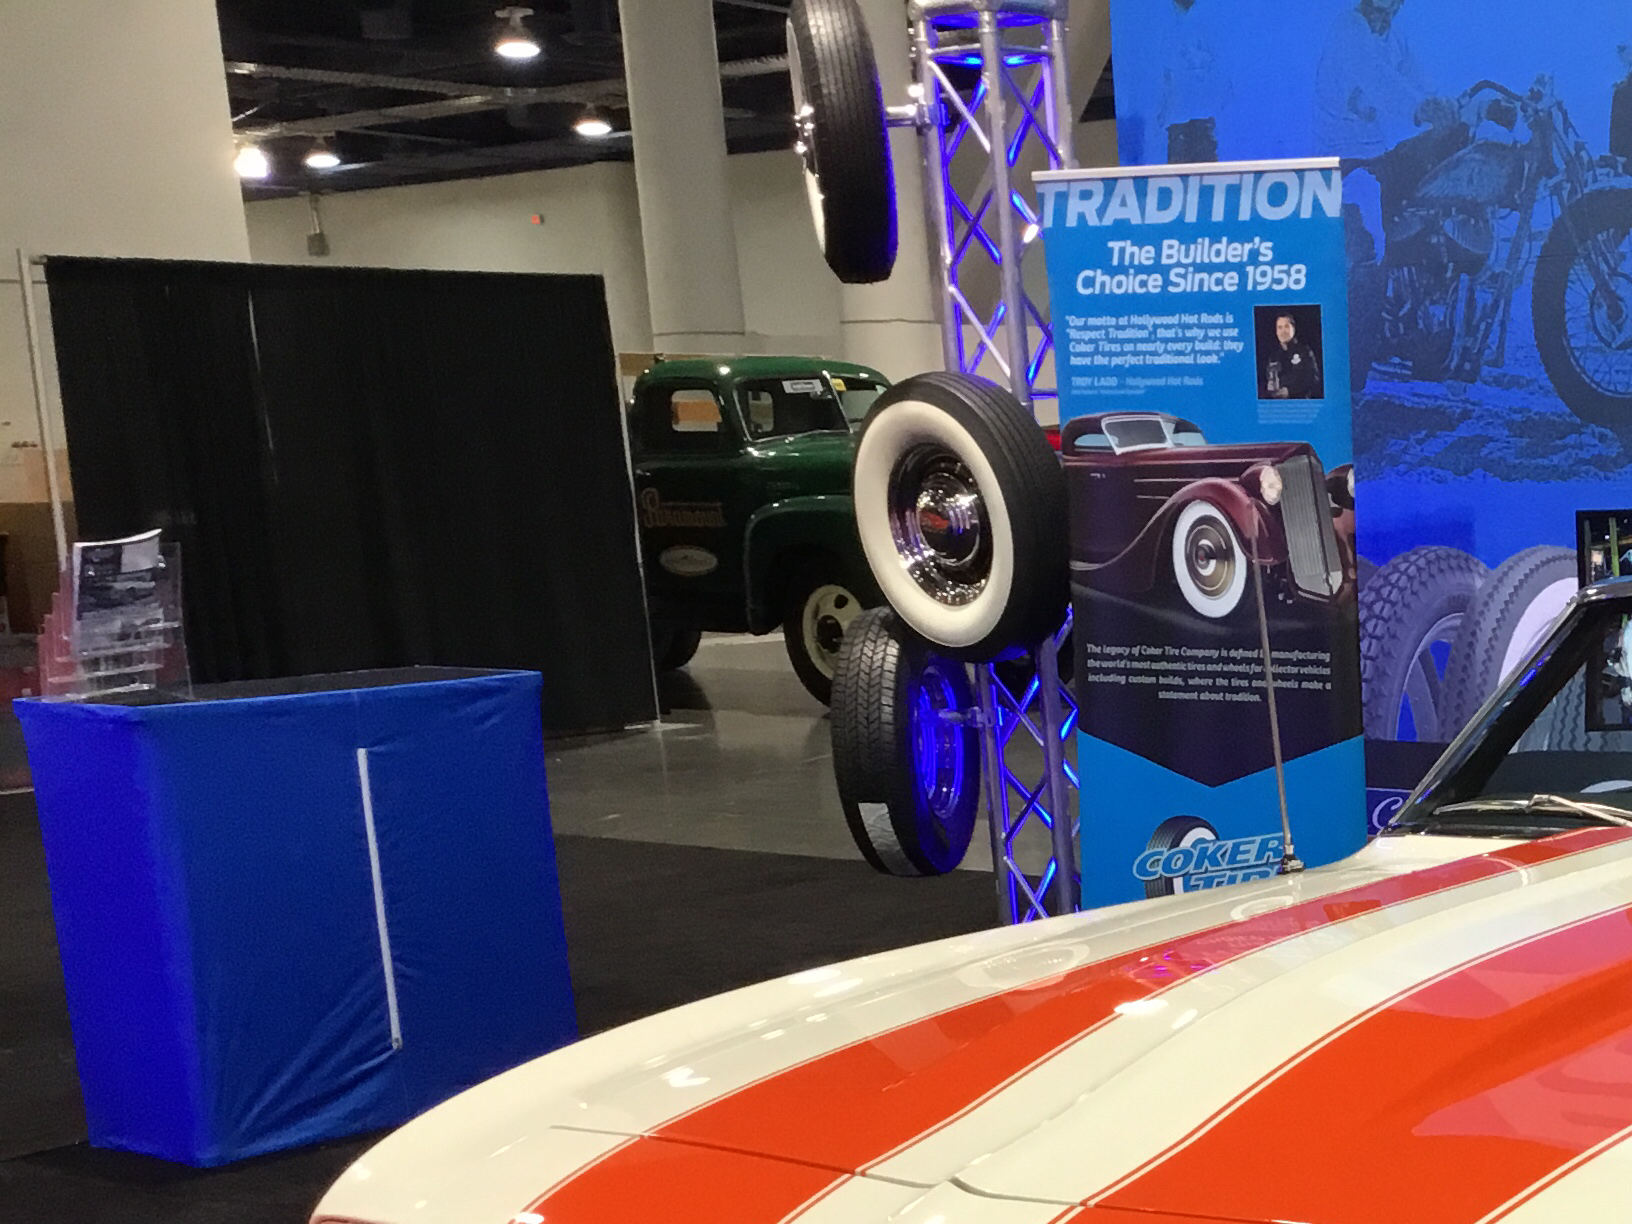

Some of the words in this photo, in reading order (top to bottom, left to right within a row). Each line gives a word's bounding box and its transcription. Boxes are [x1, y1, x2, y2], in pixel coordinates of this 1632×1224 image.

[1037, 169, 1342, 228] TRADITION
[1107, 240, 1155, 266] The
[1160, 236, 1273, 264] Builder's
[1076, 269, 1162, 295] Choice
[1167, 268, 1239, 293] Since
[1246, 264, 1307, 291] 1958
[1118, 315, 1128, 325] at
[1130, 314, 1179, 331] Hollywood
[1181, 313, 1199, 325] Hot
[1200, 313, 1224, 324] Rods
[1225, 312, 1234, 324] is
[1185, 328, 1205, 340] why
[1207, 328, 1221, 338] we
[1222, 327, 1239, 337] use
[1069, 342, 1095, 352] Coker
[1098, 341, 1121, 352] Tires
[1123, 343, 1134, 352] on
[1136, 341, 1165, 353] nearly
[1167, 342, 1193, 353] every
[1223, 340, 1244, 352] they
[1069, 355, 1092, 365] have
[1094, 355, 1109, 365] the
[1111, 354, 1144, 367] perfect
[1145, 353, 1194, 365] traditional
[1086, 643, 1101, 653] The
[1102, 644, 1130, 656] legacy
[1131, 645, 1140, 656] of
[1141, 645, 1164, 655] Coker
[1164, 646, 1180, 656] Tire
[1180, 646, 1220, 659] Company
[1220, 647, 1228, 657] is
[1229, 648, 1259, 659] defined
[1271, 650, 1331, 662] manufacturing
[1087, 659, 1101, 668] the
[1187, 661, 1206, 671] tires
[1206, 663, 1222, 671] and
[1222, 663, 1250, 672] wheels
[1250, 663, 1263, 674] for
[1300, 664, 1331, 675] vehicles
[1087, 672, 1127, 685] including
[1128, 674, 1157, 683] custom
[1187, 676, 1214, 686] where
[1215, 677, 1229, 687] the
[1231, 677, 1249, 687] tires
[1301, 680, 1323, 690] make
[1158, 690, 1198, 699] statement
[1199, 690, 1224, 700] about
[1133, 833, 1285, 880] COKER
